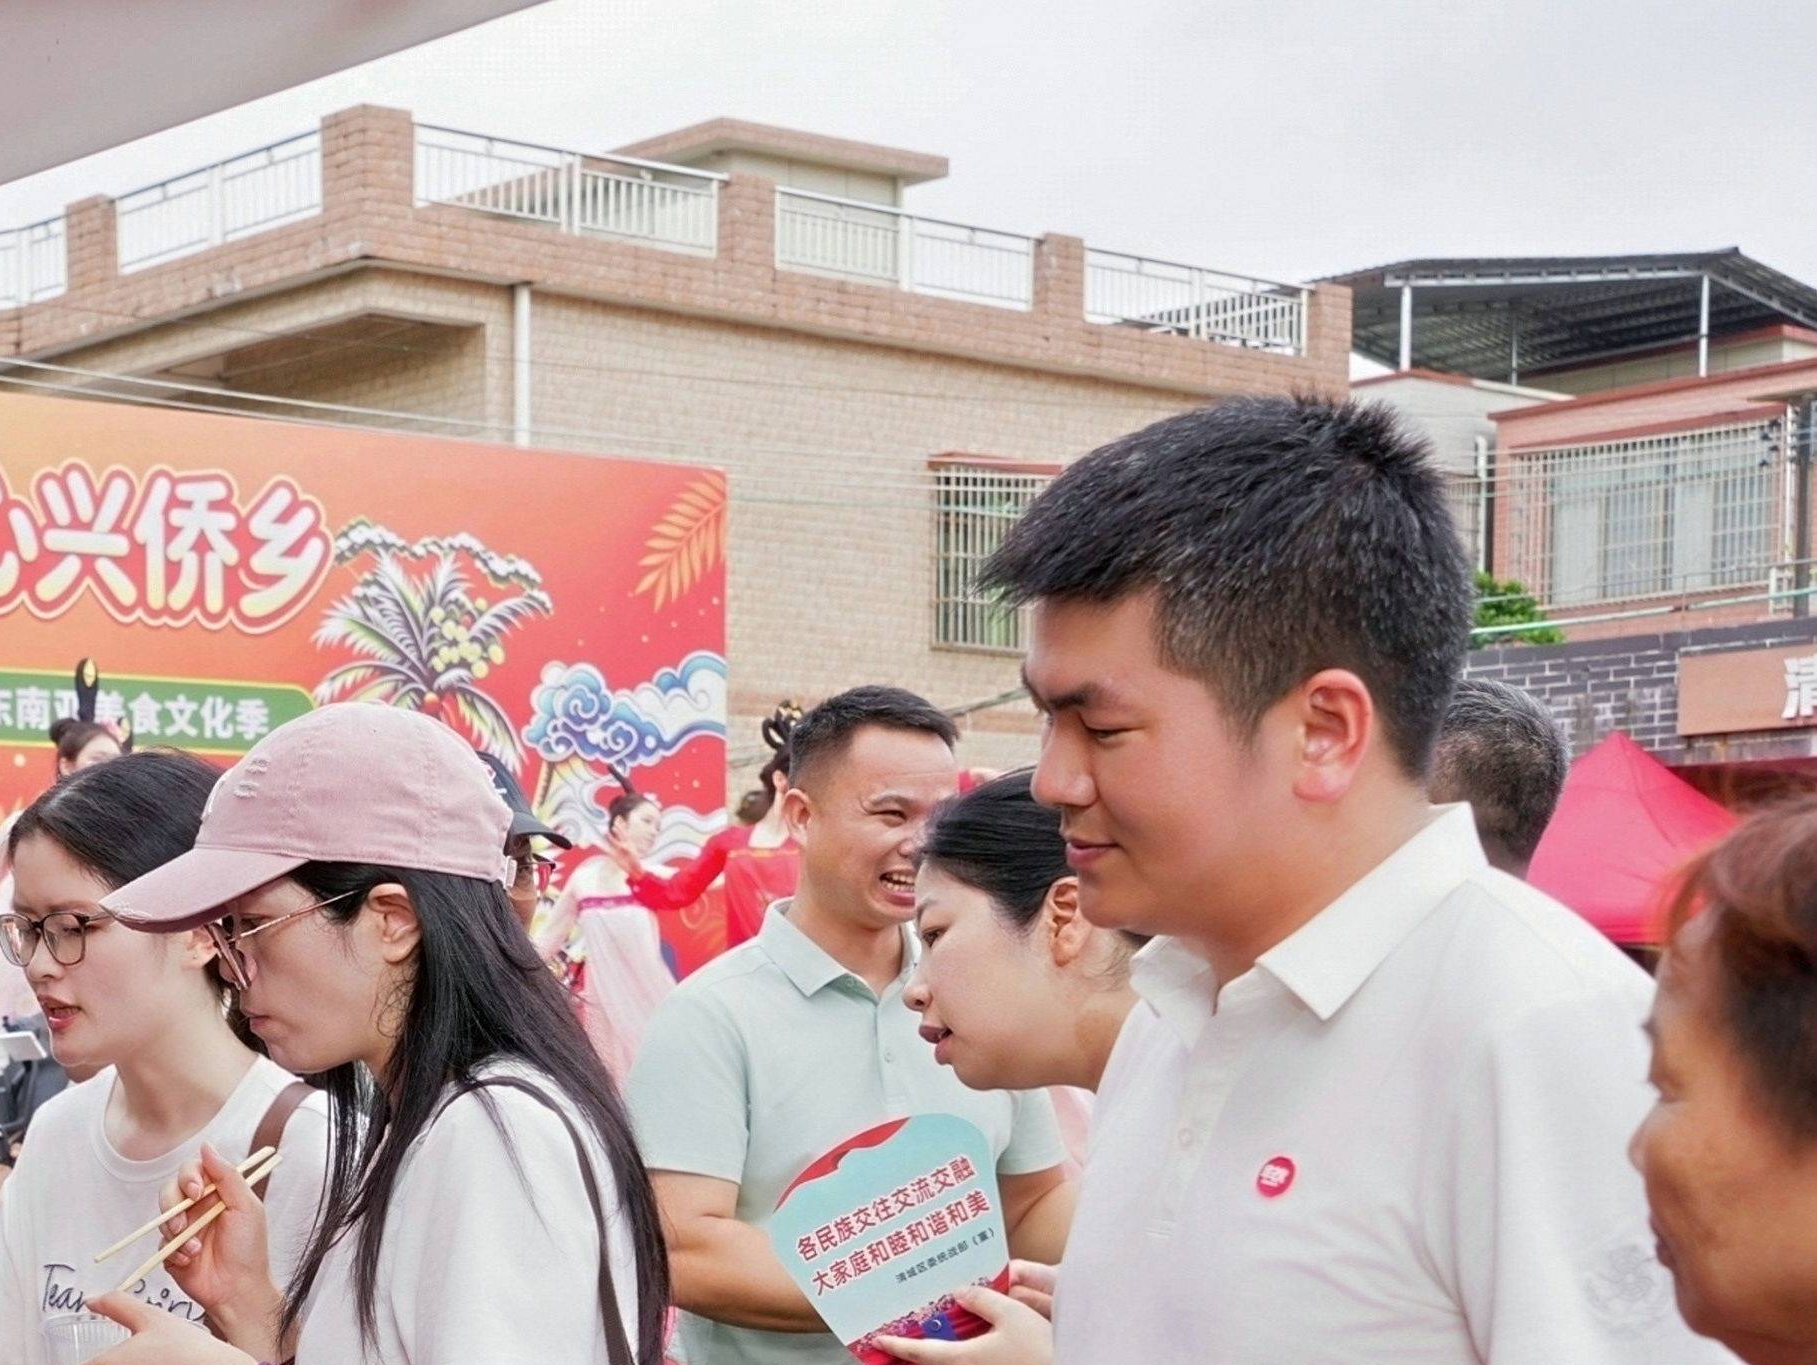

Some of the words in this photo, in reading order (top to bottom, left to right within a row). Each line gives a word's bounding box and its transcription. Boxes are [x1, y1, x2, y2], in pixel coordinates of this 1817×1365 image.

[797, 1156, 975, 1262] 各民族交往交流交融
[812, 1190, 990, 1296] 大家庭和睦和谐和美
